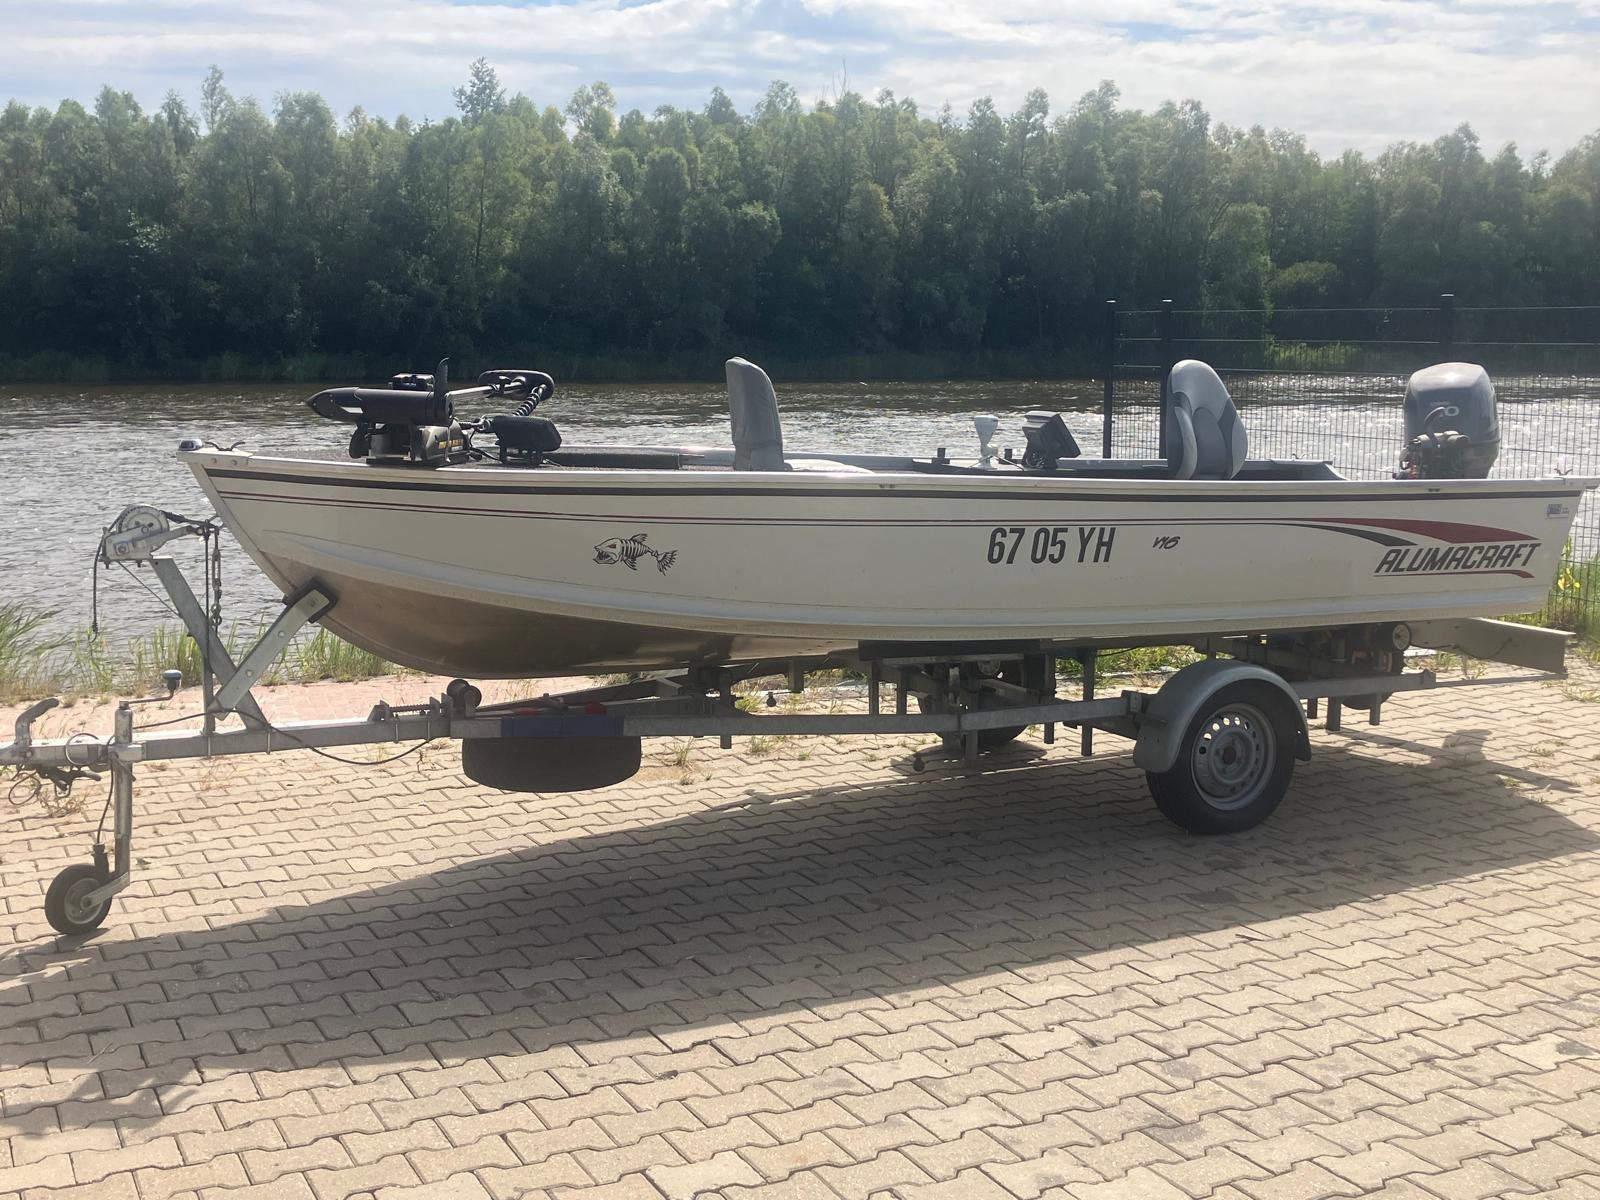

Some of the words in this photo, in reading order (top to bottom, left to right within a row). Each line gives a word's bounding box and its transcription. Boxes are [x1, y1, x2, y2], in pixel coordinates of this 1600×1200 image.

[987, 527, 1025, 564] 67
[1030, 527, 1068, 564] 05
[1077, 527, 1116, 563] YH
[1374, 542, 1542, 573] ALUMACRAFT
